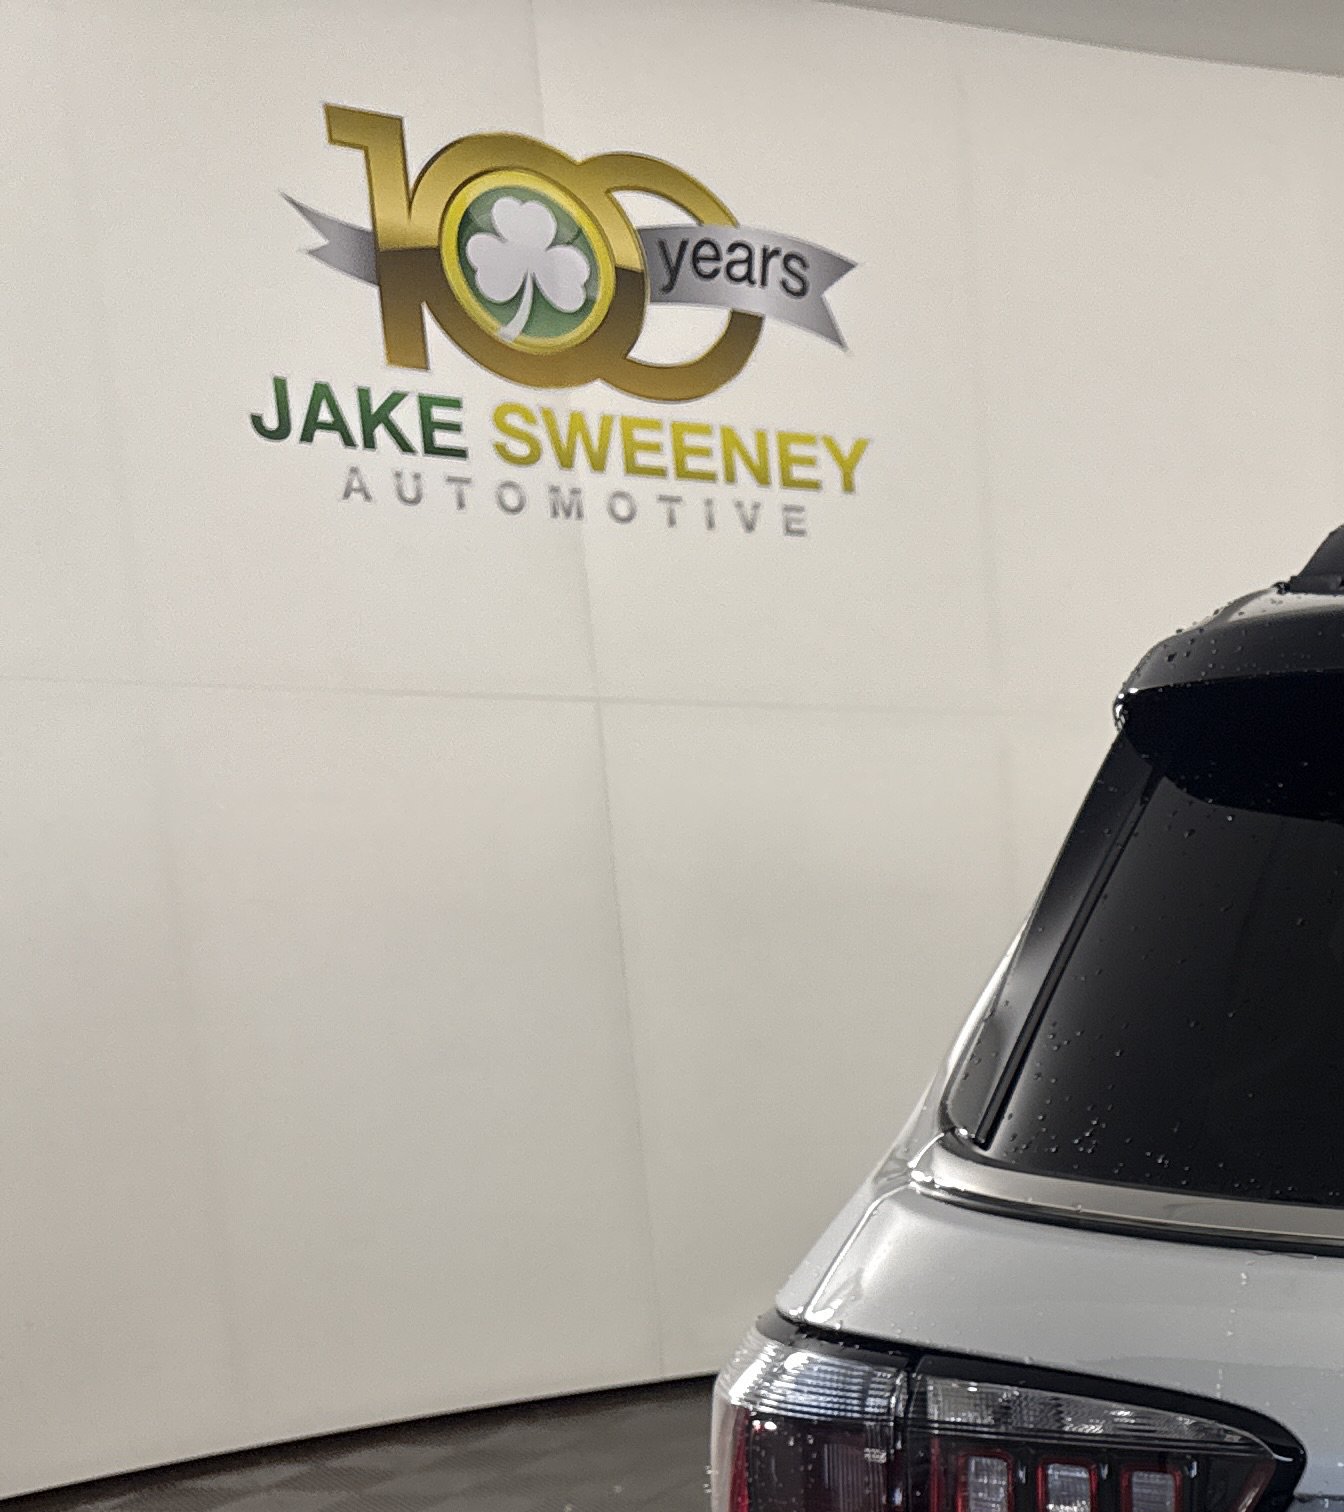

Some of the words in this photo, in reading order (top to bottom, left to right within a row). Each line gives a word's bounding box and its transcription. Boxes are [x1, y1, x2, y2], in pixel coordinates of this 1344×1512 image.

[657, 236, 810, 298] years
[250, 374, 470, 461] JAKE
[491, 401, 871, 494] SWEENEY
[341, 465, 809, 538] AUTOMOTIVE
